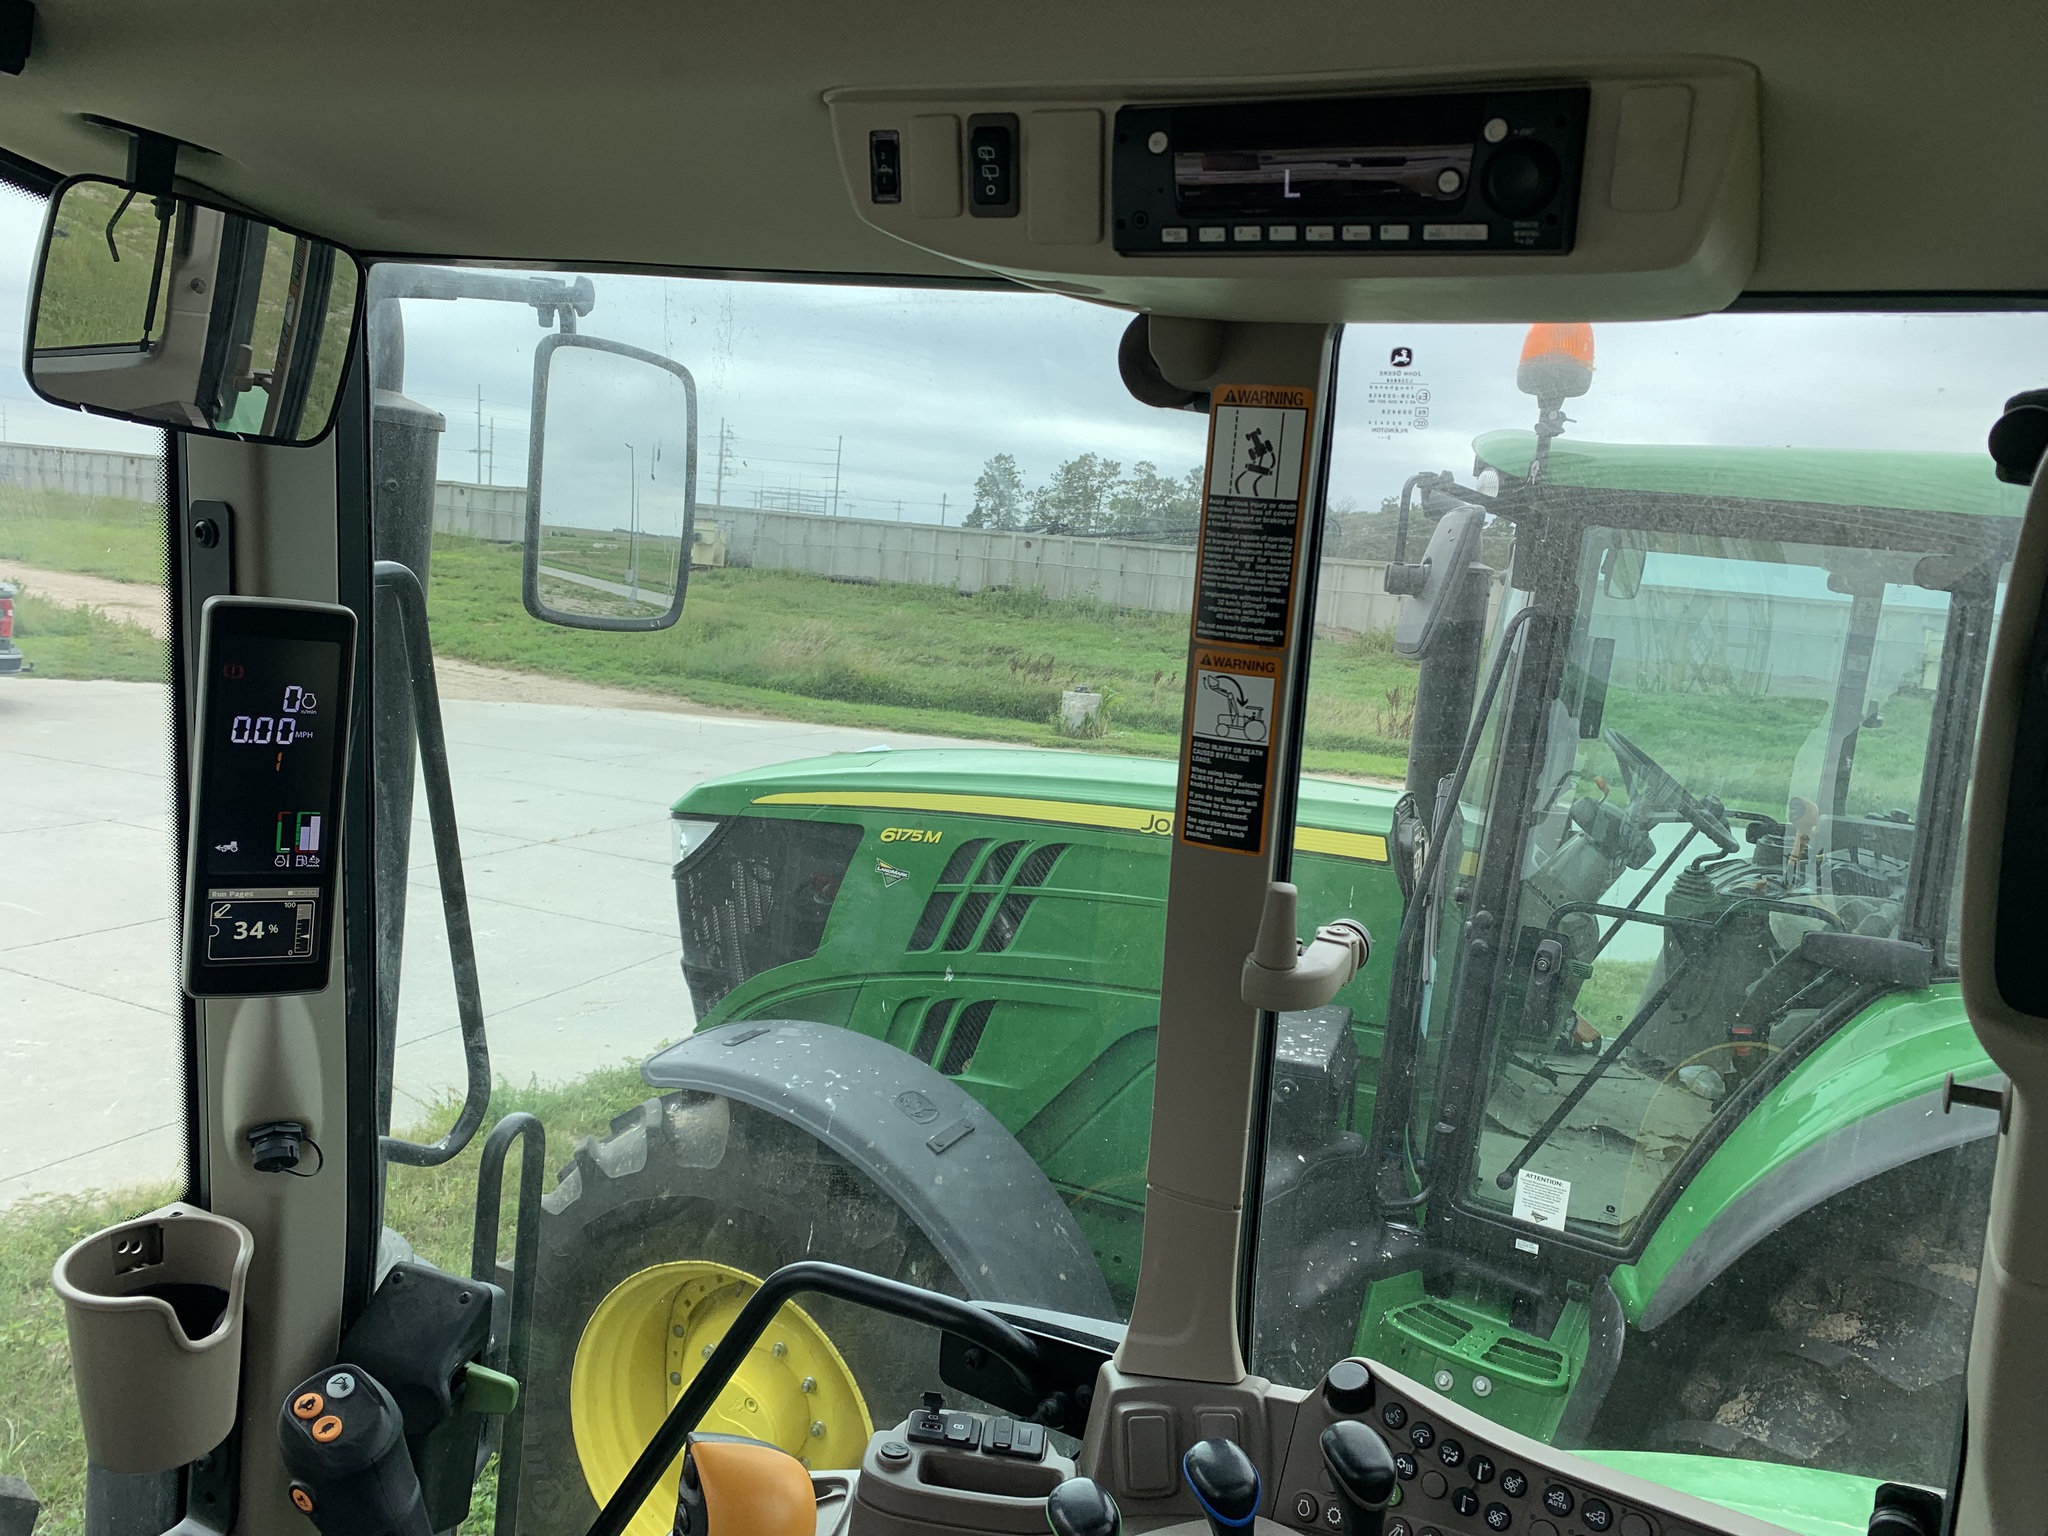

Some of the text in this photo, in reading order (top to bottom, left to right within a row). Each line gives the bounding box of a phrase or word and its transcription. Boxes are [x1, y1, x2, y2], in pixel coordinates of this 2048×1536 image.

[1238, 390, 1304, 406] WARNING
[1214, 656, 1275, 673] WARNING
[282, 685, 302, 713] 0
[231, 716, 296, 744] 0.00
[1141, 815, 1172, 832] JO
[880, 828, 942, 843] 6175M
[233, 921, 278, 940] 34 %
[1525, 1173, 1563, 1187] ATTENTION:
[1548, 1499, 1567, 1509] AUTO
